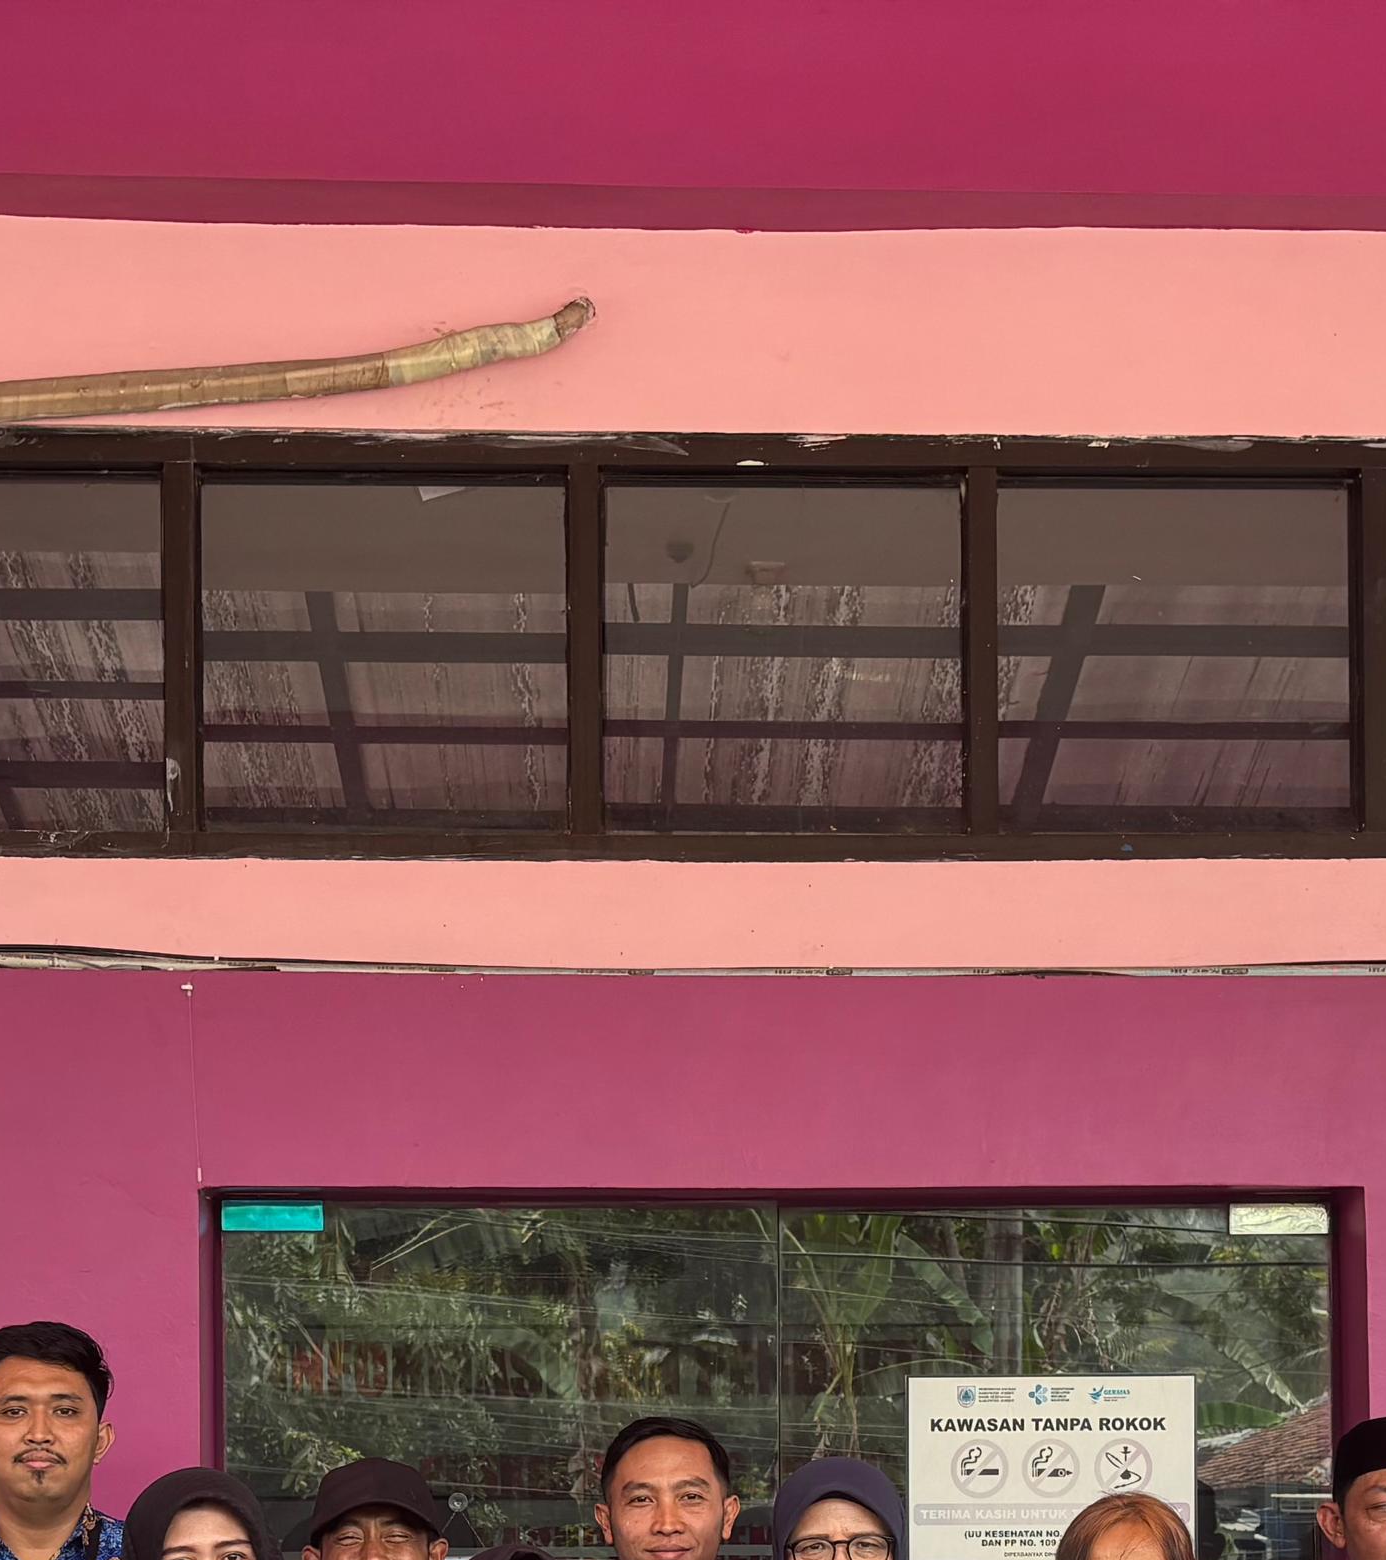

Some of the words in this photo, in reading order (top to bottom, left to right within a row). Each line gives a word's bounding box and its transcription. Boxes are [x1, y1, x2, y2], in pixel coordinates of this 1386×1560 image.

[930, 1418, 1025, 1432] KAWASAN
[1031, 1417, 1093, 1432] TANPA
[1098, 1417, 1166, 1431] ROKOK
[920, 1509, 970, 1520] TERIMA
[975, 1509, 1015, 1520] KASIH
[1021, 1509, 1067, 1520] UNTUK
[964, 1529, 982, 1539] (UU
[984, 1529, 1043, 1539] KESEHATAN
[981, 1538, 1002, 1547] DAN
[1004, 1538, 1017, 1547] PP
[1019, 1538, 1037, 1547] NO.
[1040, 1538, 1056, 1547] 109
